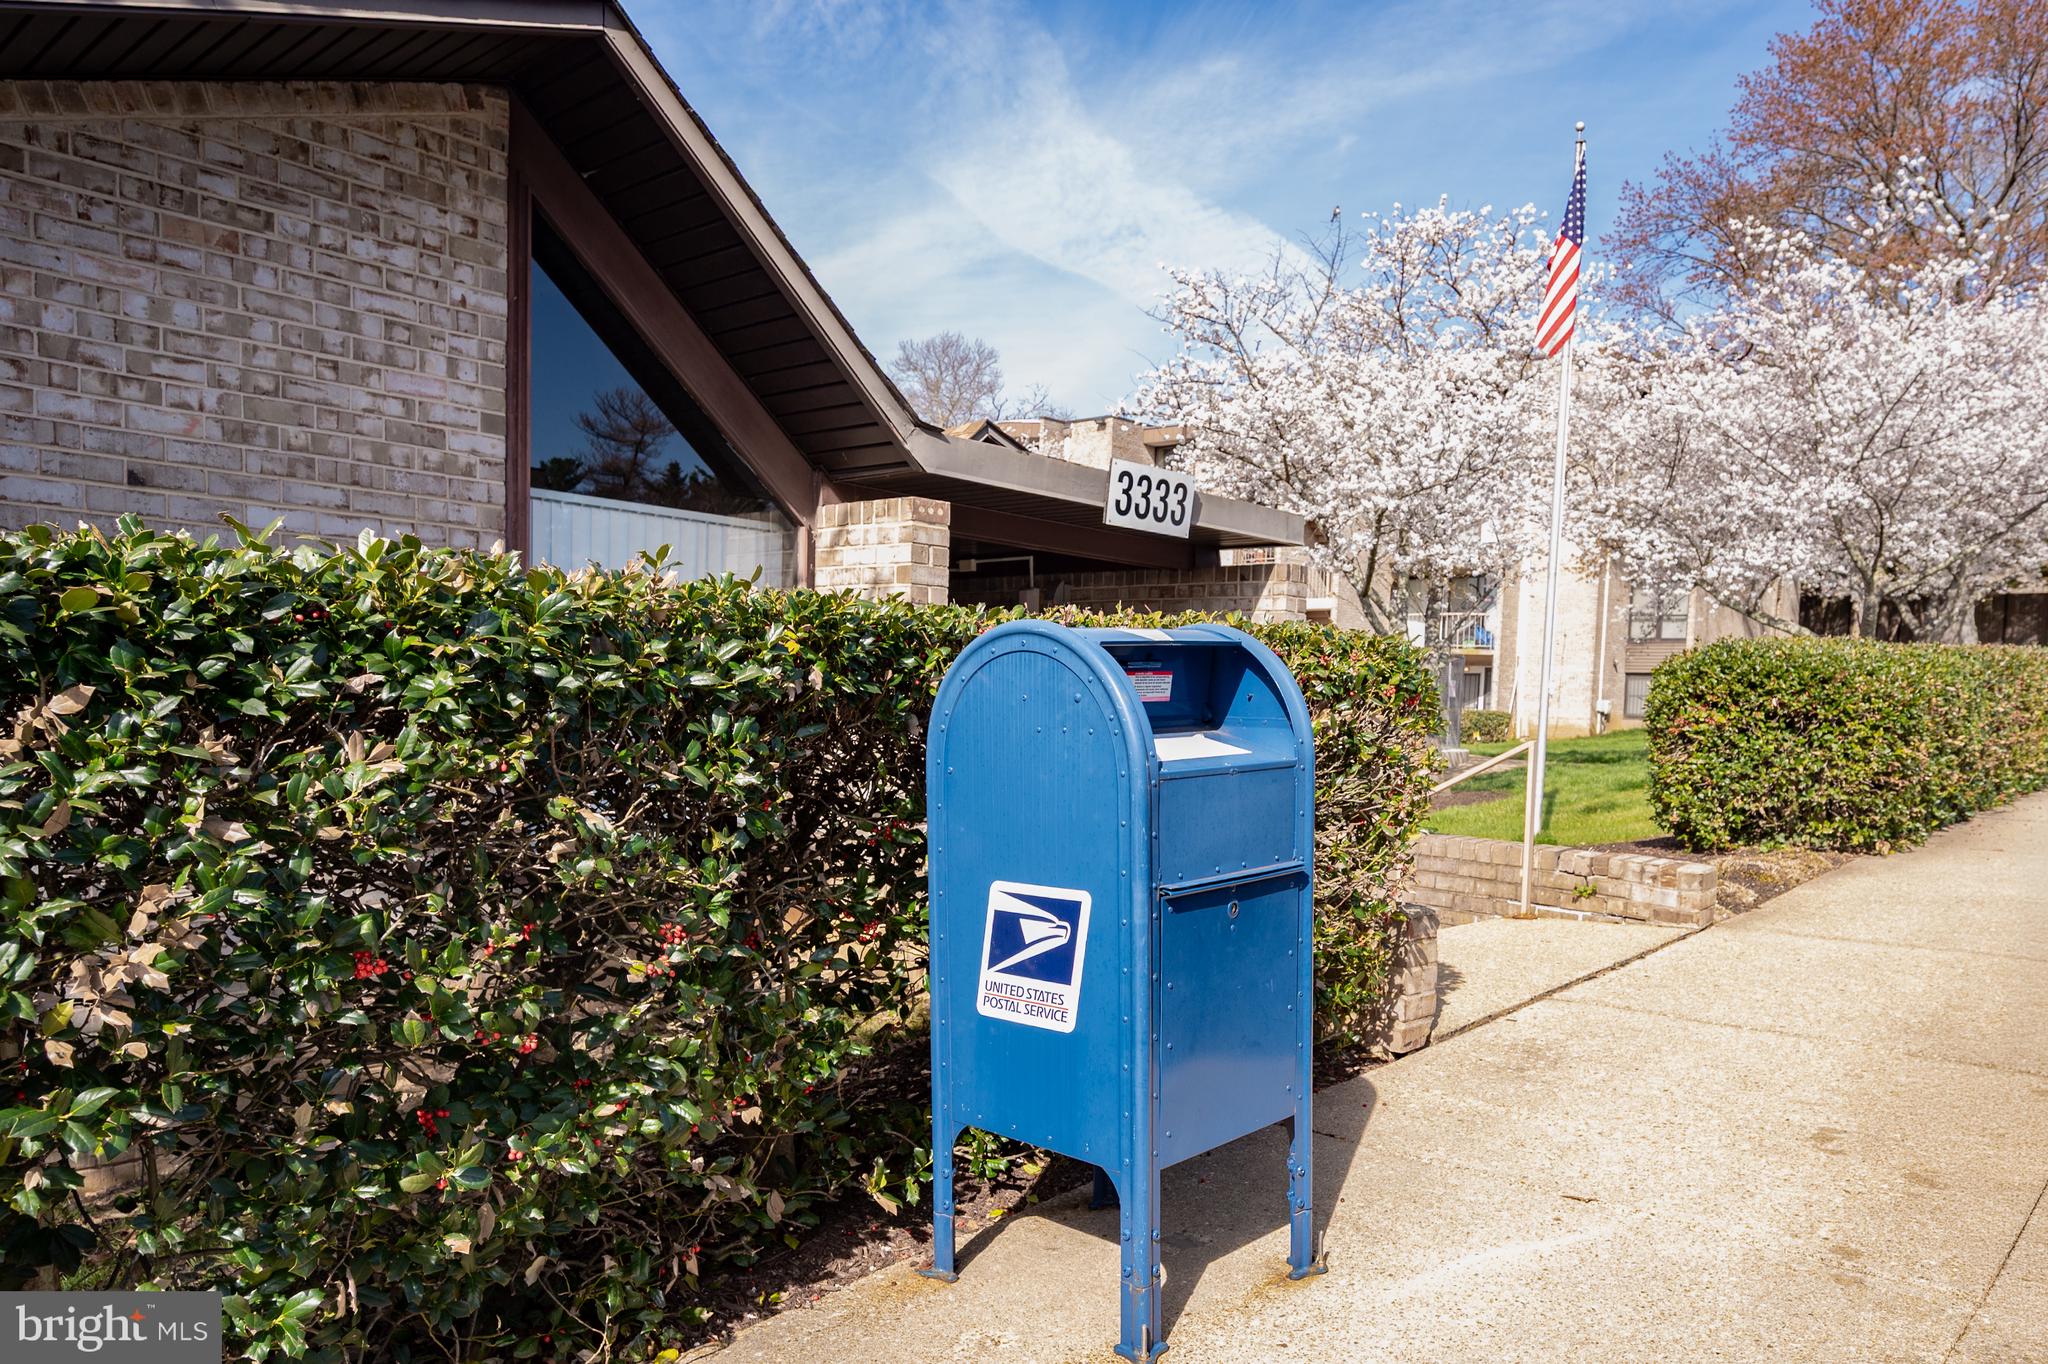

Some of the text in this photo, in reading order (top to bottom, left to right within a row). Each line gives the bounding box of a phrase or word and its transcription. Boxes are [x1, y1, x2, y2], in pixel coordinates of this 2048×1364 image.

[1115, 470, 1187, 526] 3333
[985, 980, 1065, 1006] UNITED STATES
[983, 995, 1069, 1023] POSTAL SERVICE
